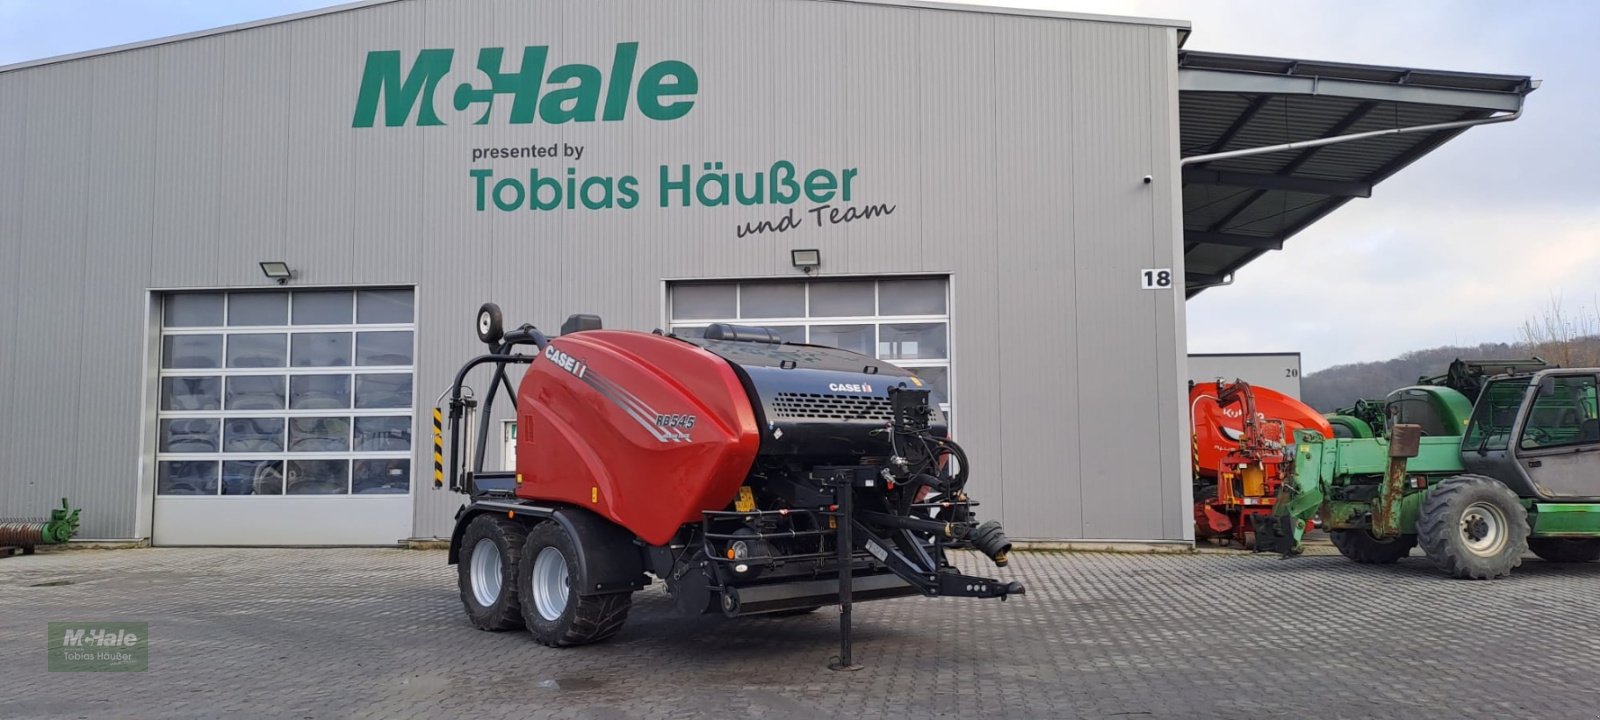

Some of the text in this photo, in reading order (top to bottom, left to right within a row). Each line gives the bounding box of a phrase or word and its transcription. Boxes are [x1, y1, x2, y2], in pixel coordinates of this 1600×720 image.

[352, 41, 699, 128] McHale
[472, 143, 584, 162] presented by
[470, 160, 857, 212] Tobias Häußer
[736, 203, 896, 238] und Team
[1144, 270, 1171, 287] 18
[545, 345, 575, 372] CASE
[1285, 368, 1298, 378] 20
[829, 382, 861, 392] CASE
